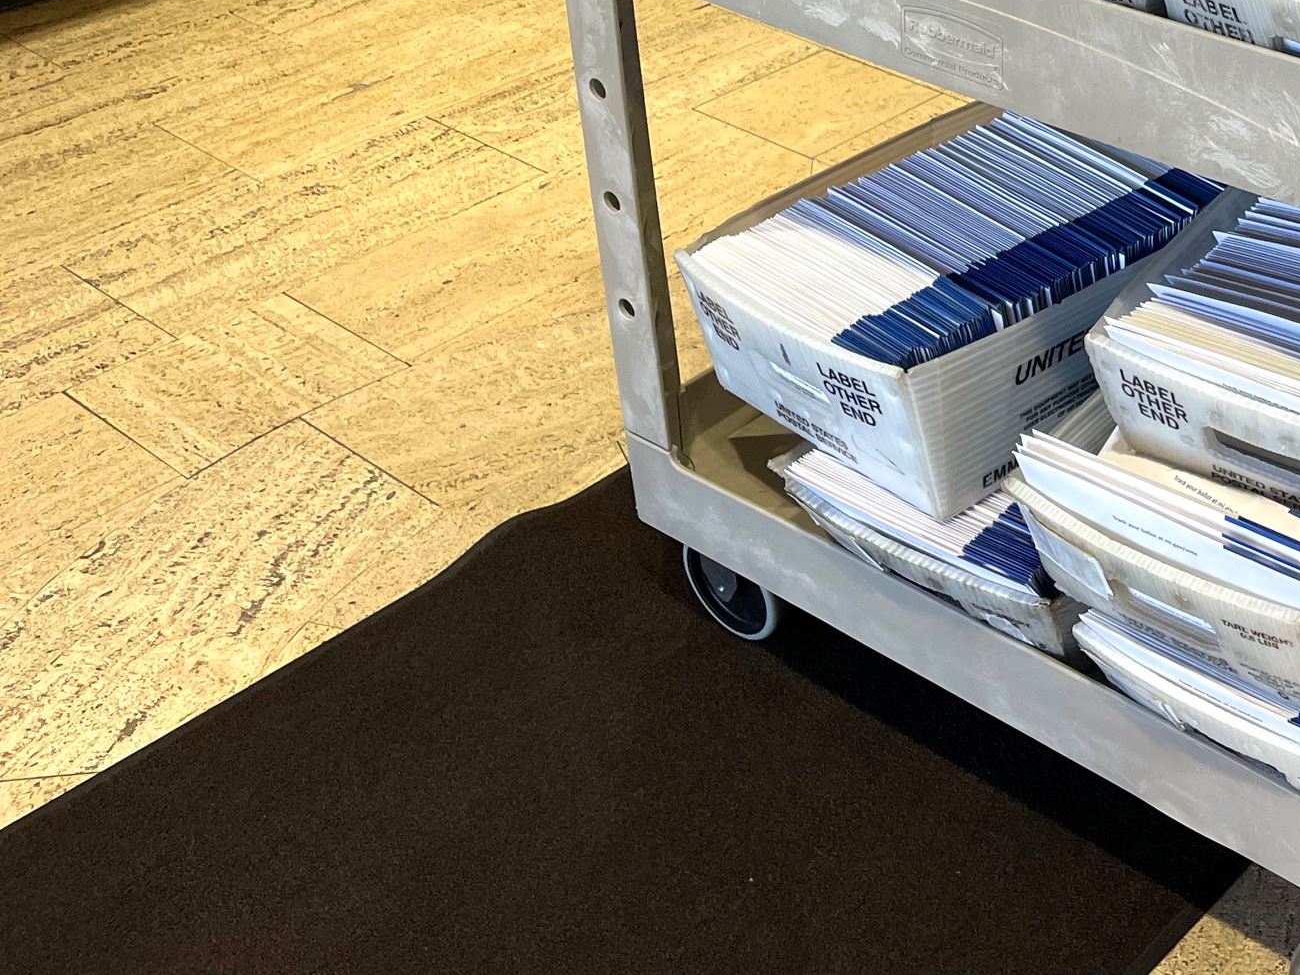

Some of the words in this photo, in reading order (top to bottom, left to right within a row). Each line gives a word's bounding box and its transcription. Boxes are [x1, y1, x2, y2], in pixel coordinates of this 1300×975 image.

[697, 291, 733, 324] LABEL
[700, 302, 741, 341] OTHER
[713, 323, 739, 350] END
[817, 363, 876, 397] LABEL
[1120, 369, 1183, 408] LABEL
[824, 380, 883, 414] OTHER
[1121, 383, 1188, 423] OTHER
[841, 402, 876, 426] END
[1140, 403, 1180, 431] END
[1212, 464, 1266, 491] UNITED
